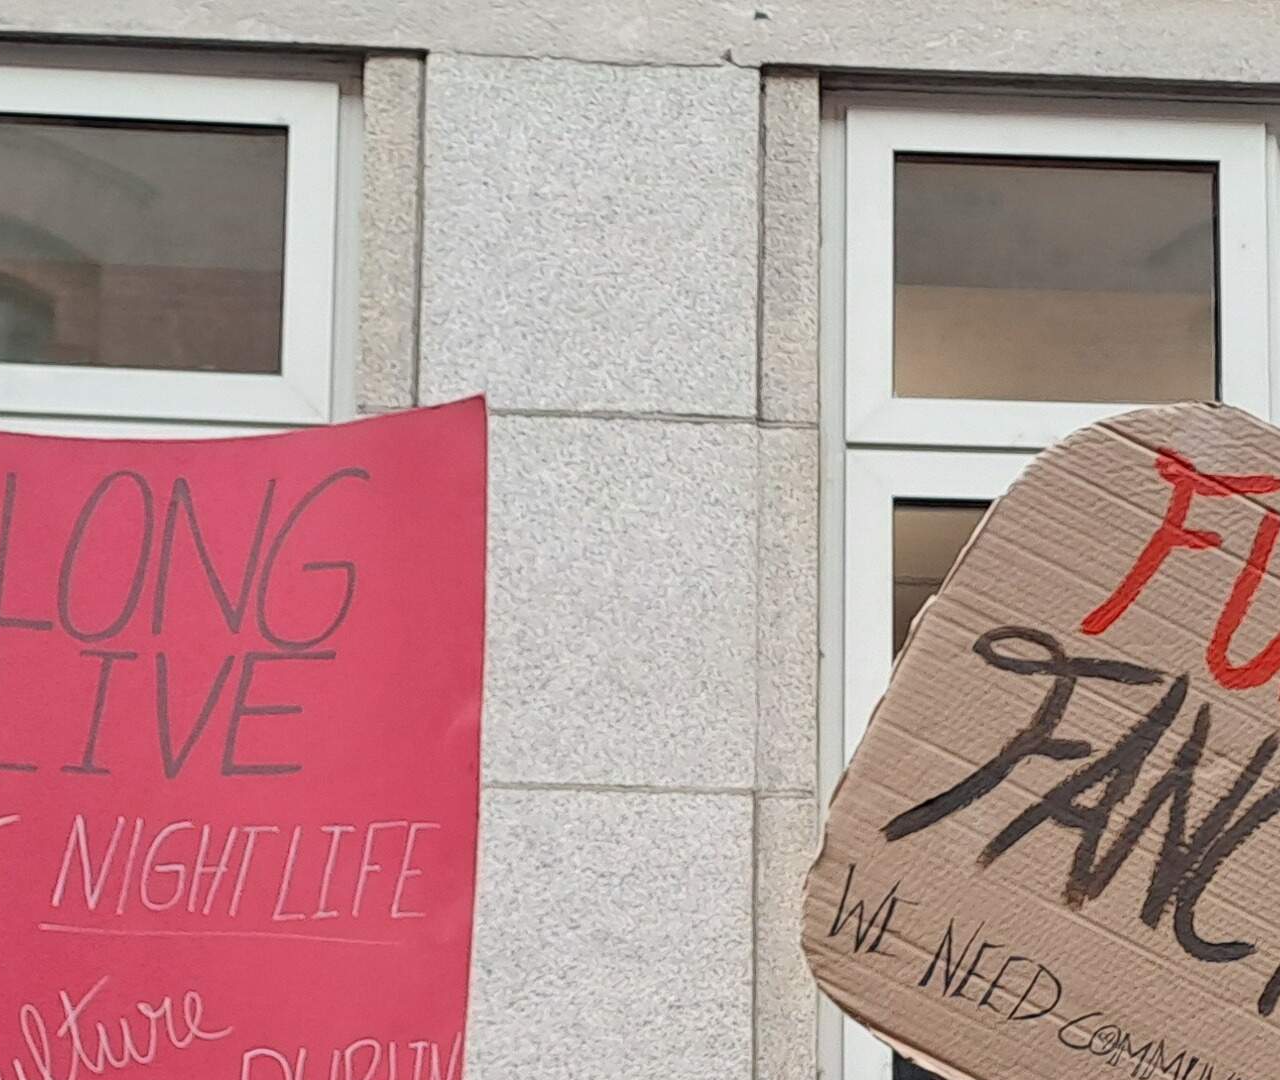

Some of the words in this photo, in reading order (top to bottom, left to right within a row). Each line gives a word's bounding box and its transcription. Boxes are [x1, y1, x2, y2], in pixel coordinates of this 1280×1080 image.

[51, 813, 442, 922] NIGHTLIFE
[827, 864, 919, 958] WE
[918, 917, 1062, 1022] NEED
